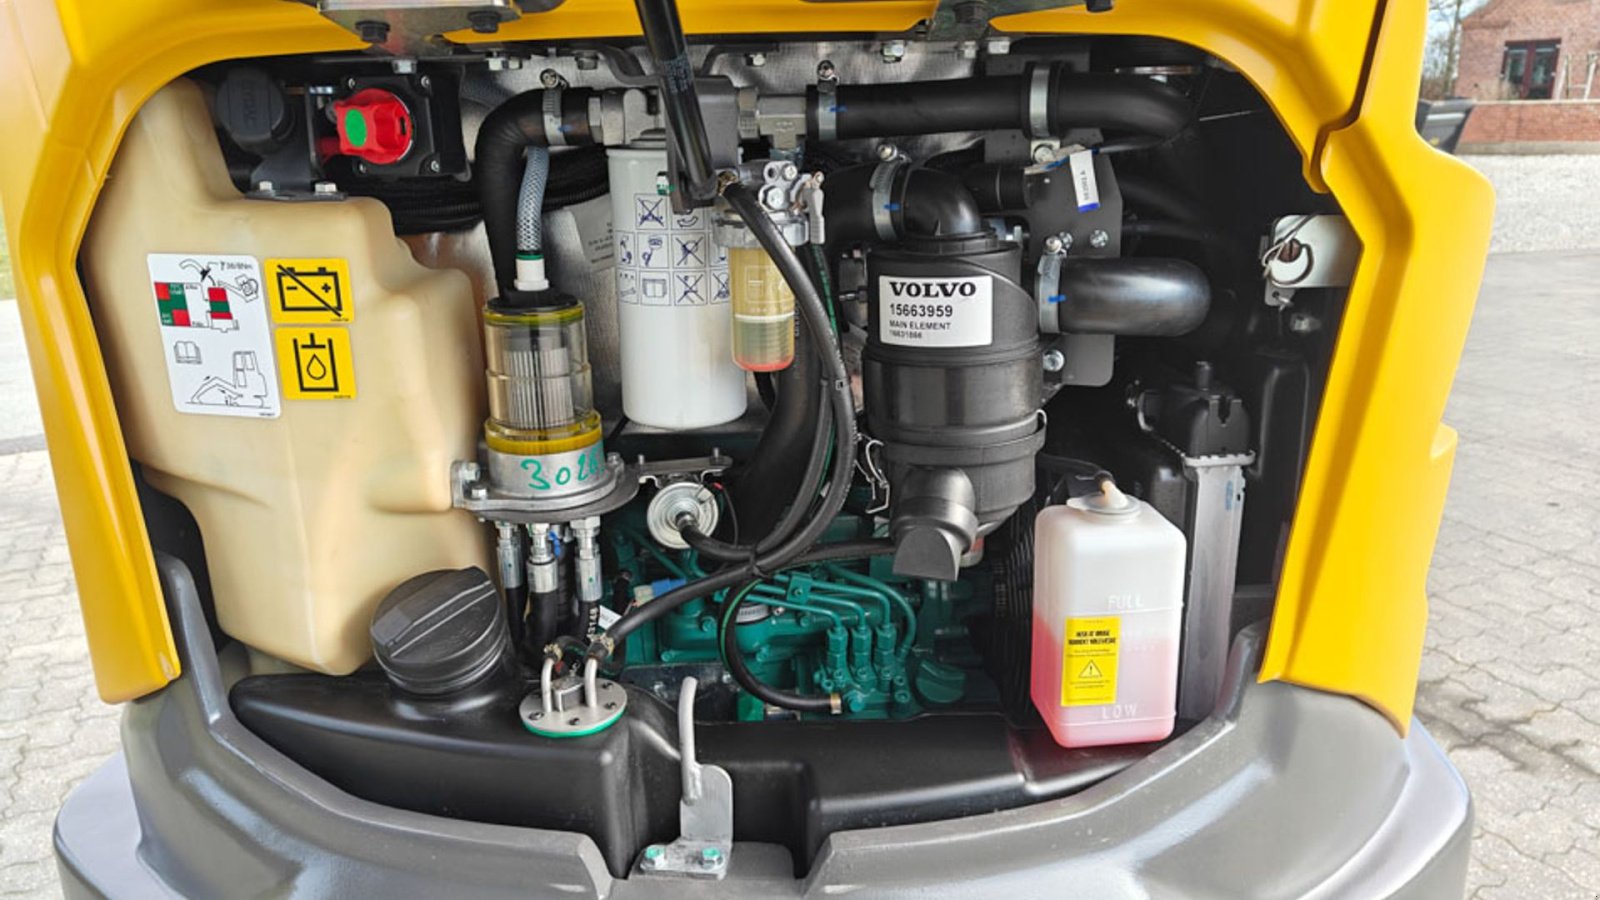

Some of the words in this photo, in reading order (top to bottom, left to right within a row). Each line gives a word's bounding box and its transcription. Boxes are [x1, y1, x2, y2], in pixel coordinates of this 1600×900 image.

[889, 281, 977, 298] VOLVO
[889, 303, 953, 317] 15663959
[889, 320, 907, 328] MAIN
[909, 321, 951, 330] ELEMENT
[1107, 594, 1145, 610] FULL
[1101, 703, 1138, 720] LOW
